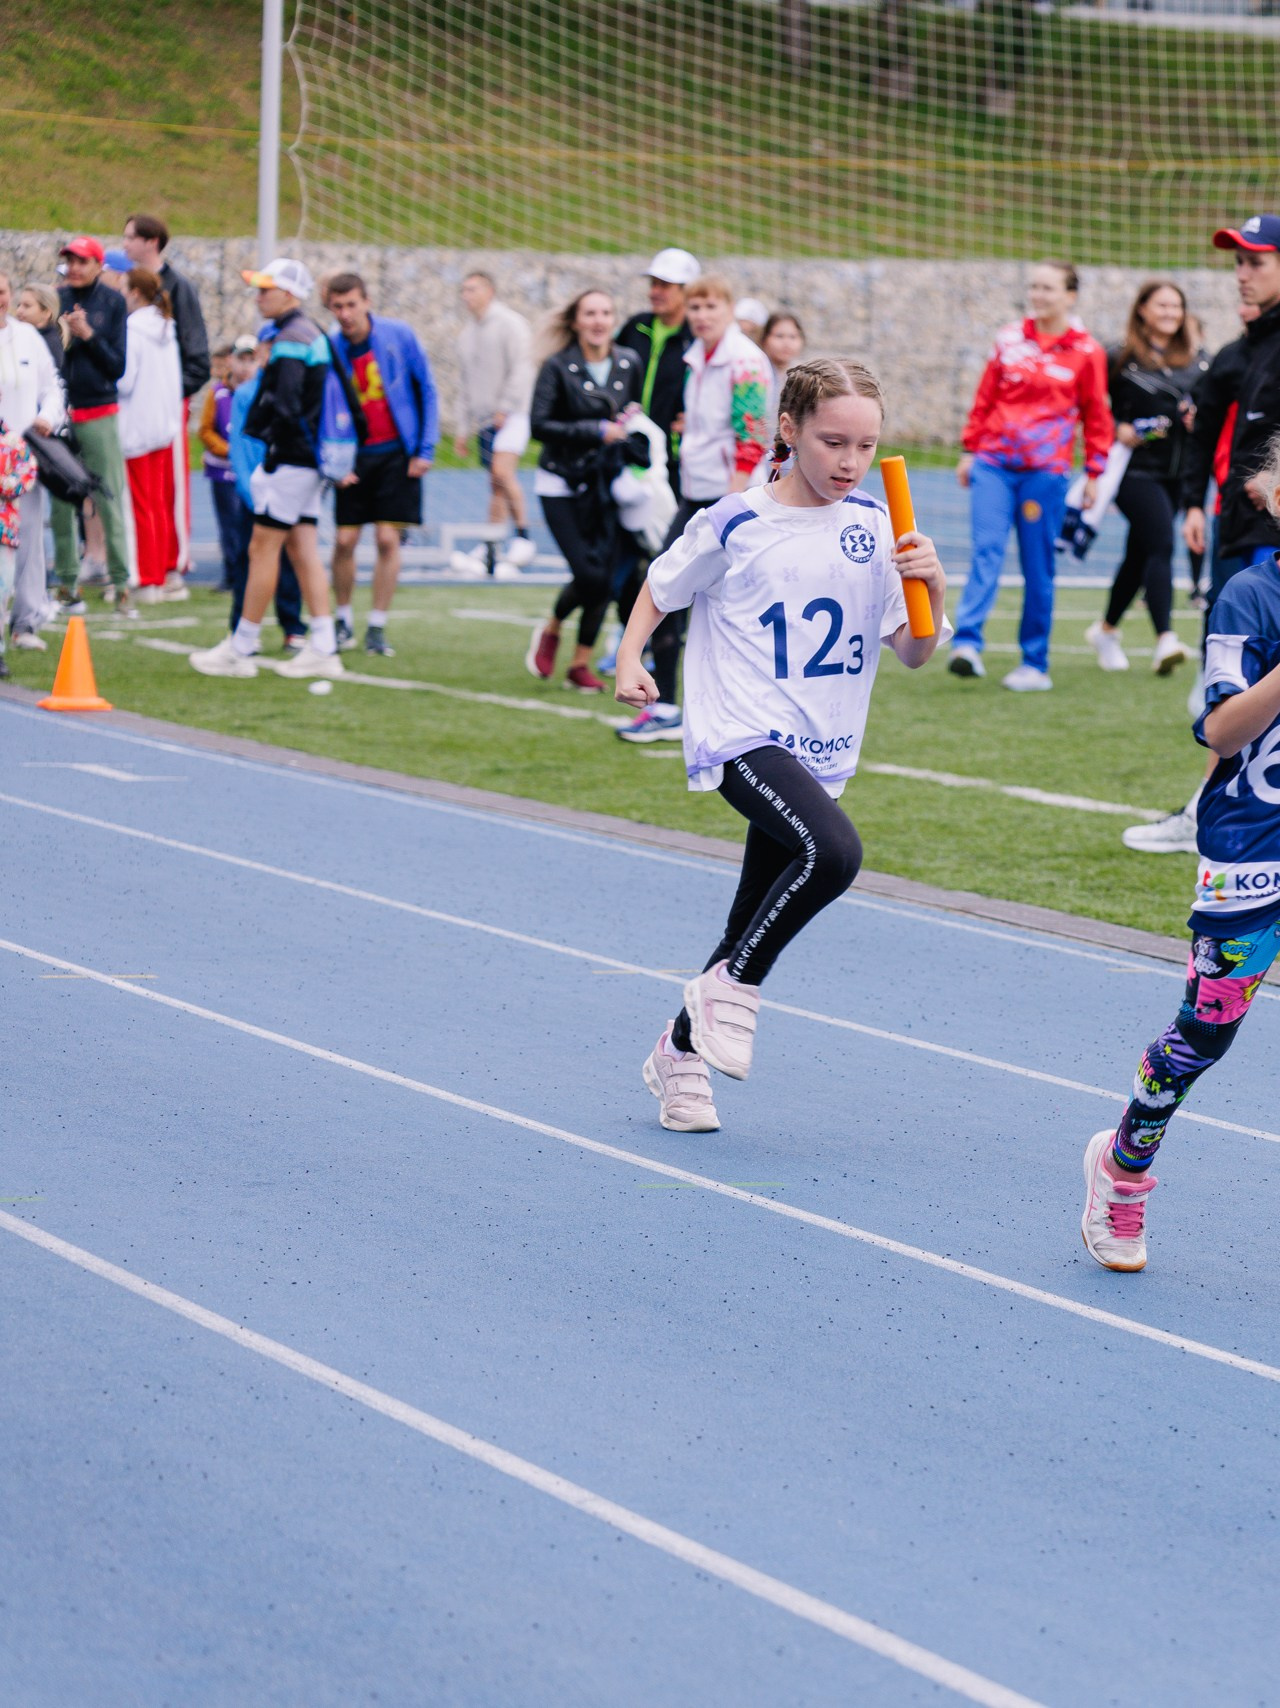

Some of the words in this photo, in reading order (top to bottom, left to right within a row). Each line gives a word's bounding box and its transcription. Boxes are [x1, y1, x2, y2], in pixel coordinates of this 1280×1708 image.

[738, 762, 758, 787] WILD
[756, 783, 776, 801] SHY
[771, 796, 786, 811] BE
[780, 808, 809, 838] DON'T
